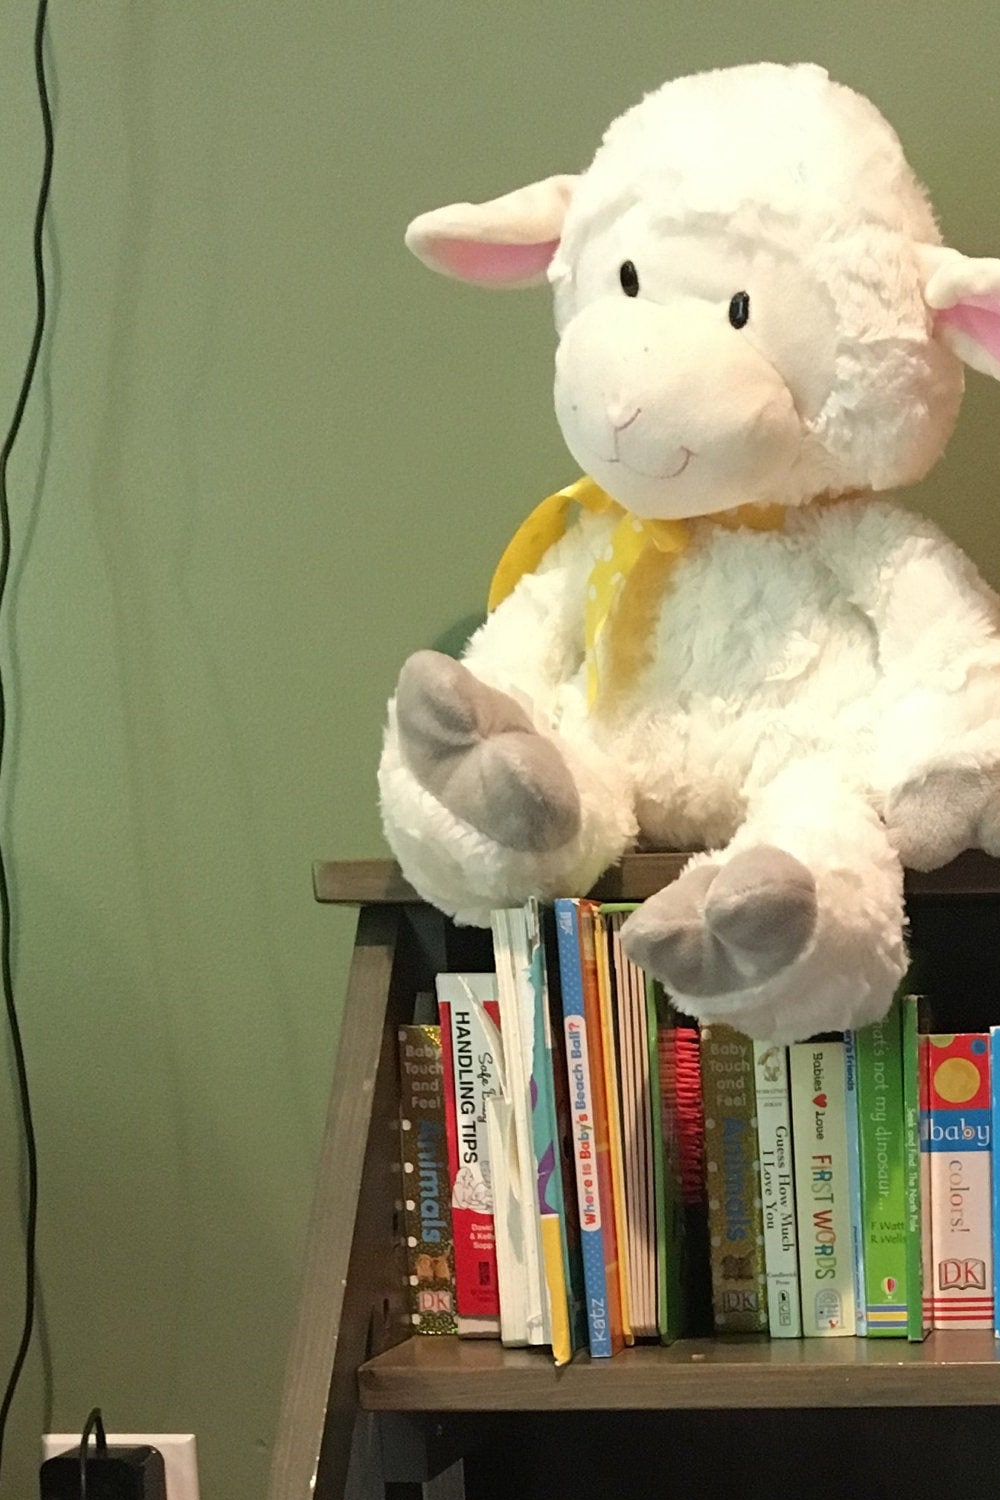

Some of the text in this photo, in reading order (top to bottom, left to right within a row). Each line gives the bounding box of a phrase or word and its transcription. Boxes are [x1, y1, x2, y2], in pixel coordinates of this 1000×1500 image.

[568, 1022, 582, 1059] Ball?
[710, 1043, 748, 1059] Baby
[404, 1062, 443, 1074] Touch
[477, 1052, 493, 1087] Safe
[710, 1060, 750, 1073] Touch
[813, 1052, 825, 1092] Babies
[873, 1062, 889, 1090] not
[411, 1079, 439, 1092] and
[455, 1011, 478, 1164] HANDLING TIPS
[572, 1063, 586, 1110] Beach
[716, 1076, 745, 1089] and
[411, 1096, 441, 1109] Feel
[870, 1096, 886, 1122] my
[576, 1113, 592, 1160] Baby's
[907, 1130, 917, 1147] and
[930, 1118, 990, 1147] baby
[417, 1119, 447, 1243] Animals
[722, 1117, 751, 1241] Animals
[763, 1163, 776, 1196] Love
[776, 1125, 795, 1252] Guess How Much
[811, 1155, 834, 1204] FIRST
[908, 1172, 917, 1187] The
[584, 1179, 597, 1225] Where
[908, 1189, 918, 1212] North
[949, 1160, 970, 1233] colors!
[765, 1202, 777, 1230] You
[813, 1209, 837, 1280] WORDS
[944, 1261, 981, 1286] DK
[422, 1292, 450, 1310] DK
[727, 1293, 755, 1310] DK
[590, 1298, 607, 1342] katz
